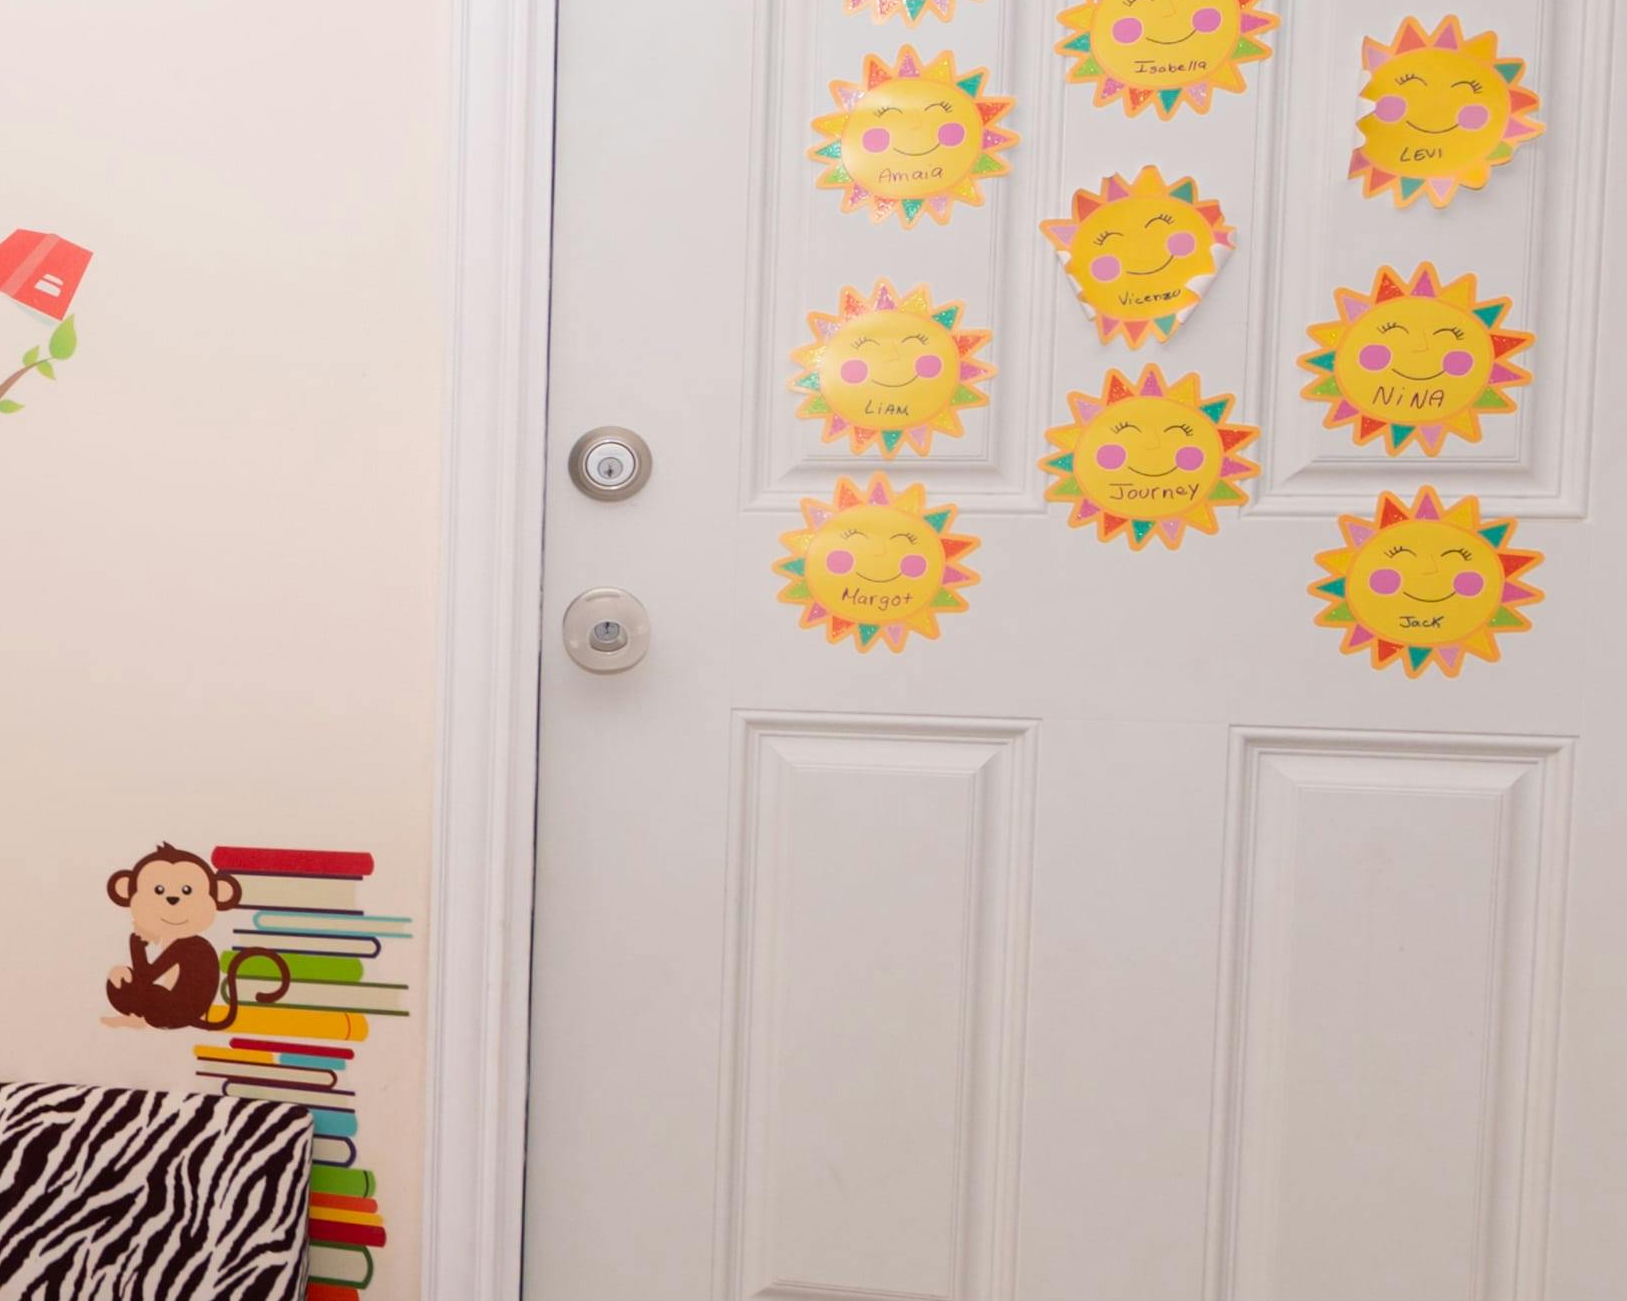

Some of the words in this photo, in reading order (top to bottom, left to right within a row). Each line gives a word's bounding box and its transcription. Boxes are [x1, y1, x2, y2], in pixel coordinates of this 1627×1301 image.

[877, 166, 945, 184] Amaia
[1109, 482, 1201, 501] Journey
[841, 587, 914, 611] Margot
[1398, 614, 1446, 629] Jack
